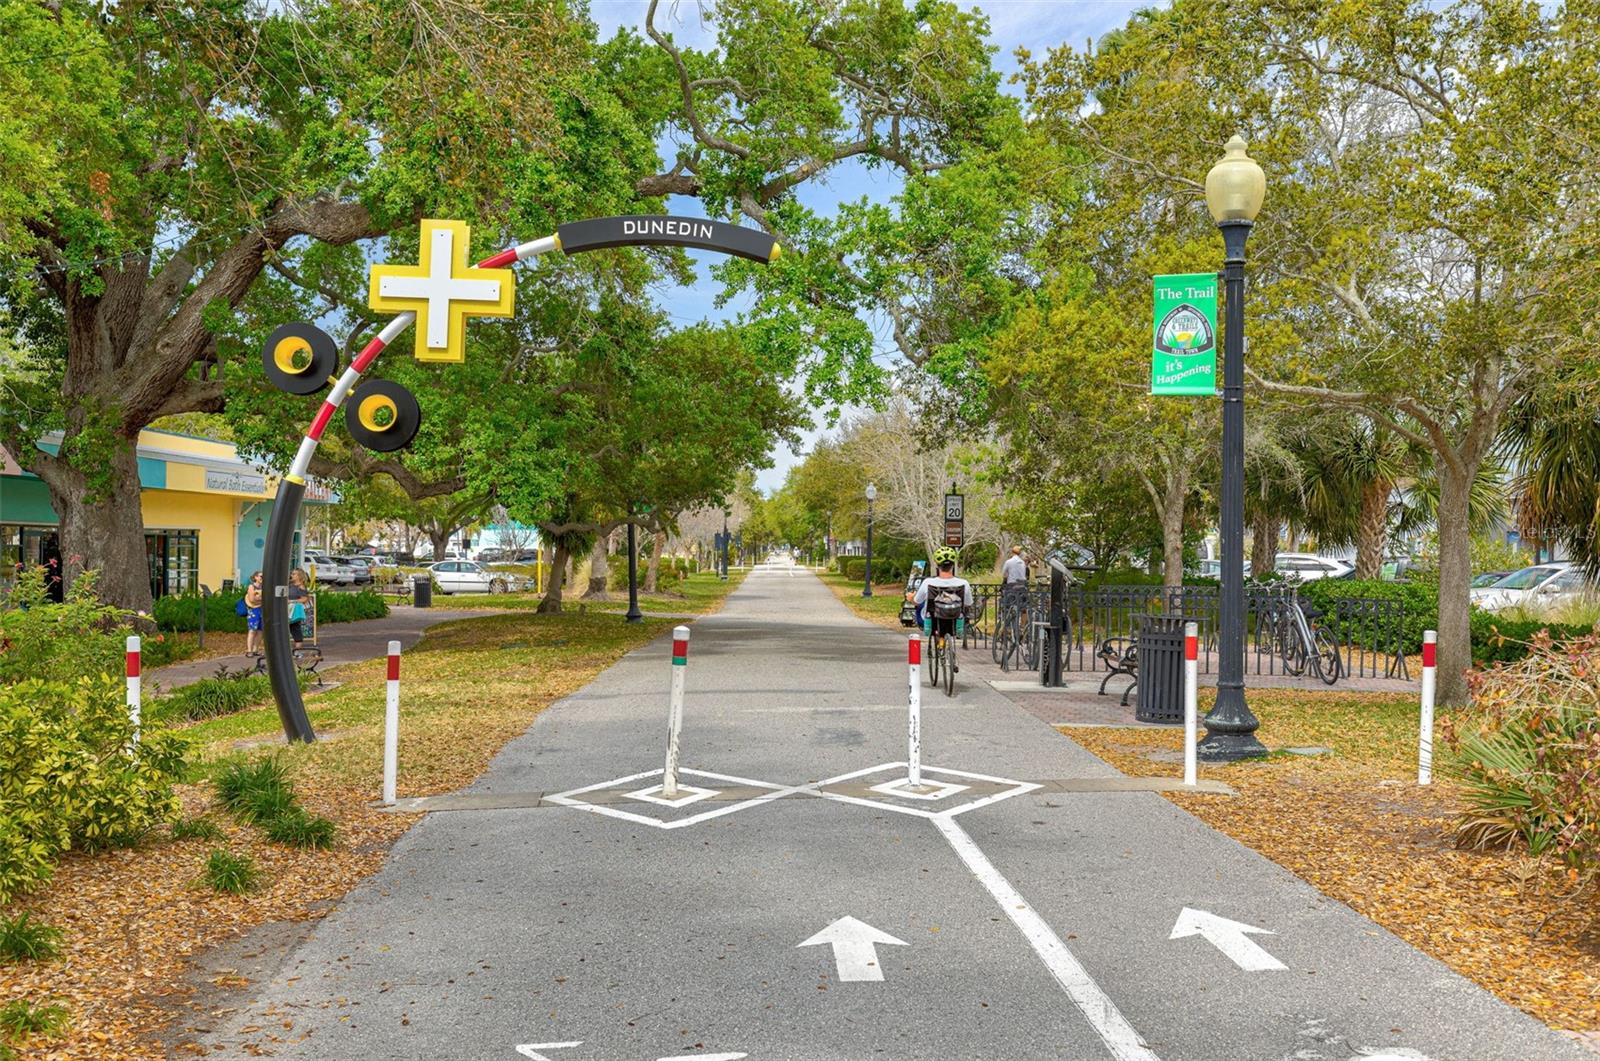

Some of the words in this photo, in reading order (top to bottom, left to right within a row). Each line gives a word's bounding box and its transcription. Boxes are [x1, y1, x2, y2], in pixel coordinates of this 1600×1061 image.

[623, 220, 713, 239] DUNEDIN
[1157, 287, 1183, 300] The
[1185, 286, 1214, 299] Trail
[1165, 359, 1183, 373] it's
[1157, 365, 1211, 384] Happening
[207, 477, 228, 490] Natural
[229, 479, 240, 491] Bath
[948, 507, 961, 518] 20
